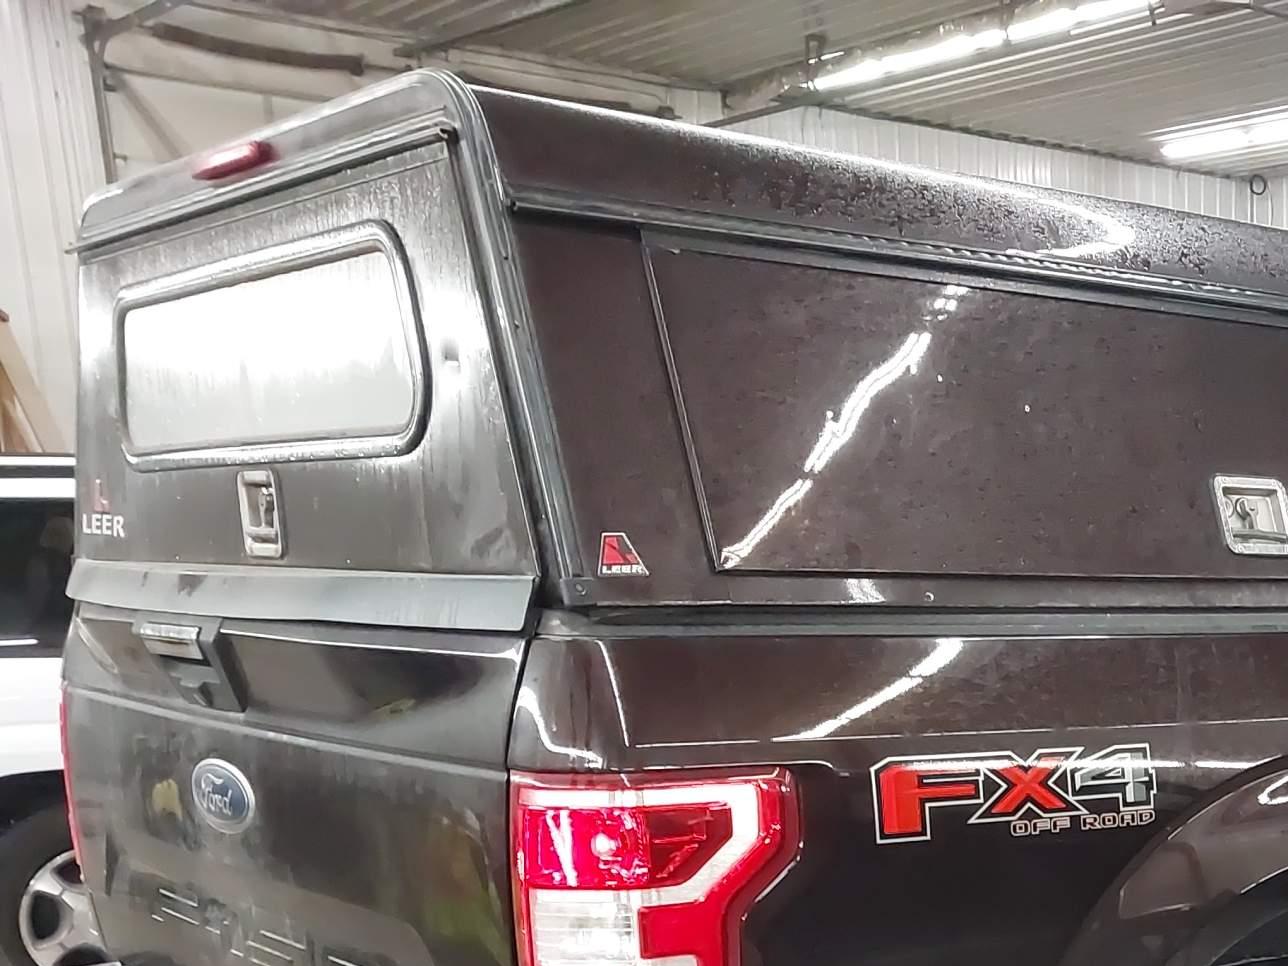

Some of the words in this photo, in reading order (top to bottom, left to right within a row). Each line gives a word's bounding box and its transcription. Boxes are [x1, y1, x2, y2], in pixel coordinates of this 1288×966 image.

[82, 513, 126, 538] LEER
[870, 743, 1157, 844] FX4
[1010, 815, 1071, 837] OFF
[1080, 809, 1156, 831] ROAD
